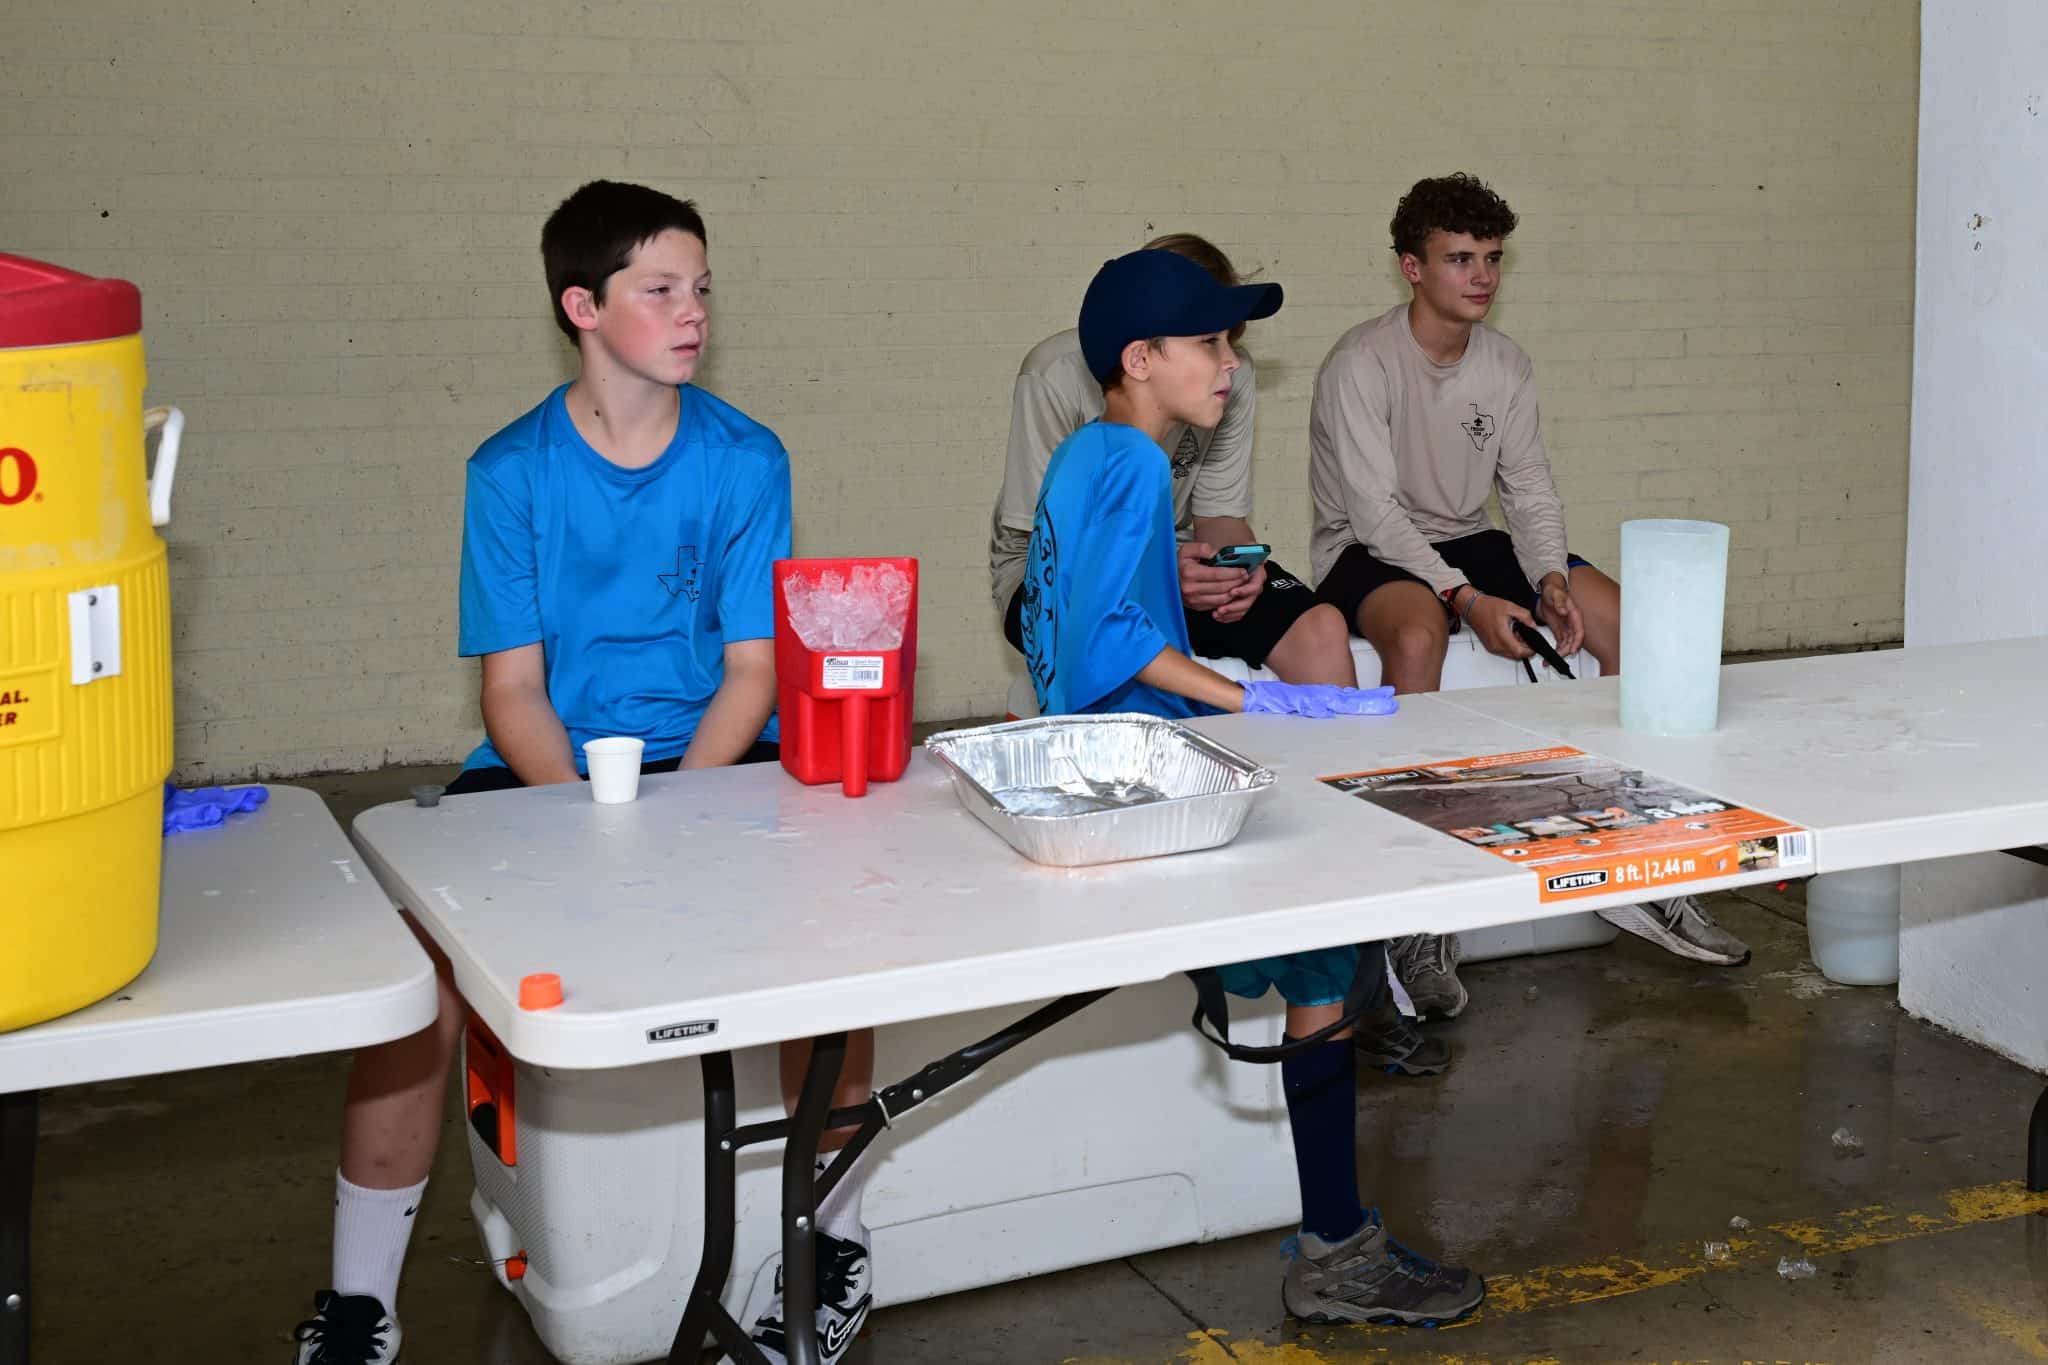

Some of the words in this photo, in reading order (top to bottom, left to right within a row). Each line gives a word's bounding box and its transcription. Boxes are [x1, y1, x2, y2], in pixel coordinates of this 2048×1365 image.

[1552, 872, 1602, 889] LIFETIME
[1615, 866, 1625, 883] 8
[1627, 863, 1643, 881] ft.
[1651, 858, 1681, 879] 2,44
[1683, 859, 1696, 873] m
[655, 1022, 710, 1040] LIFETIME
